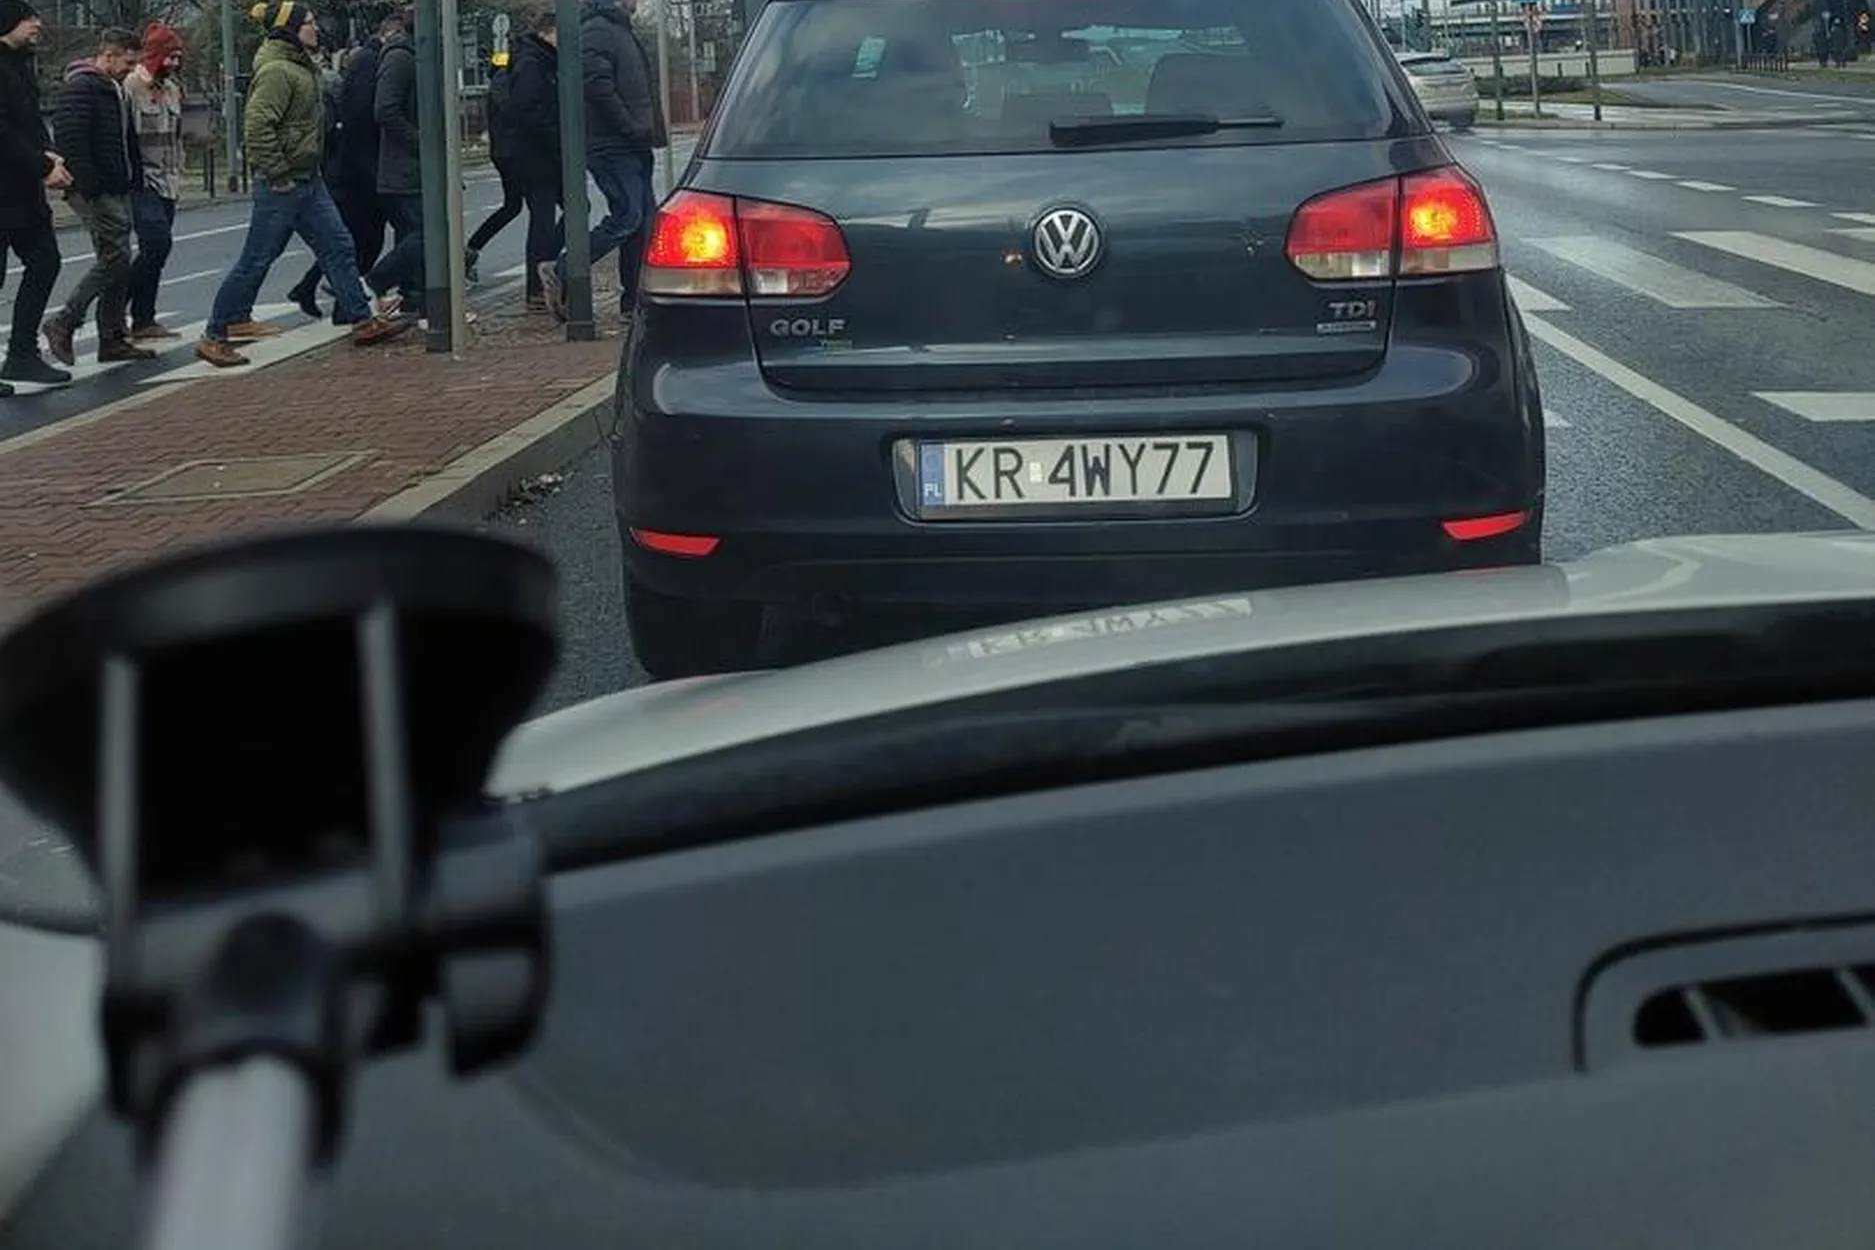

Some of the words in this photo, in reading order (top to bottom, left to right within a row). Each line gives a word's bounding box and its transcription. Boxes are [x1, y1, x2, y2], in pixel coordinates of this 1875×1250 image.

[1035, 210, 1099, 273] VW
[1328, 300, 1376, 319] TDI
[770, 319, 846, 337] GOLF
[956, 447, 1024, 500] KR
[1048, 441, 1215, 497] 4WY77
[924, 483, 942, 497] PL
